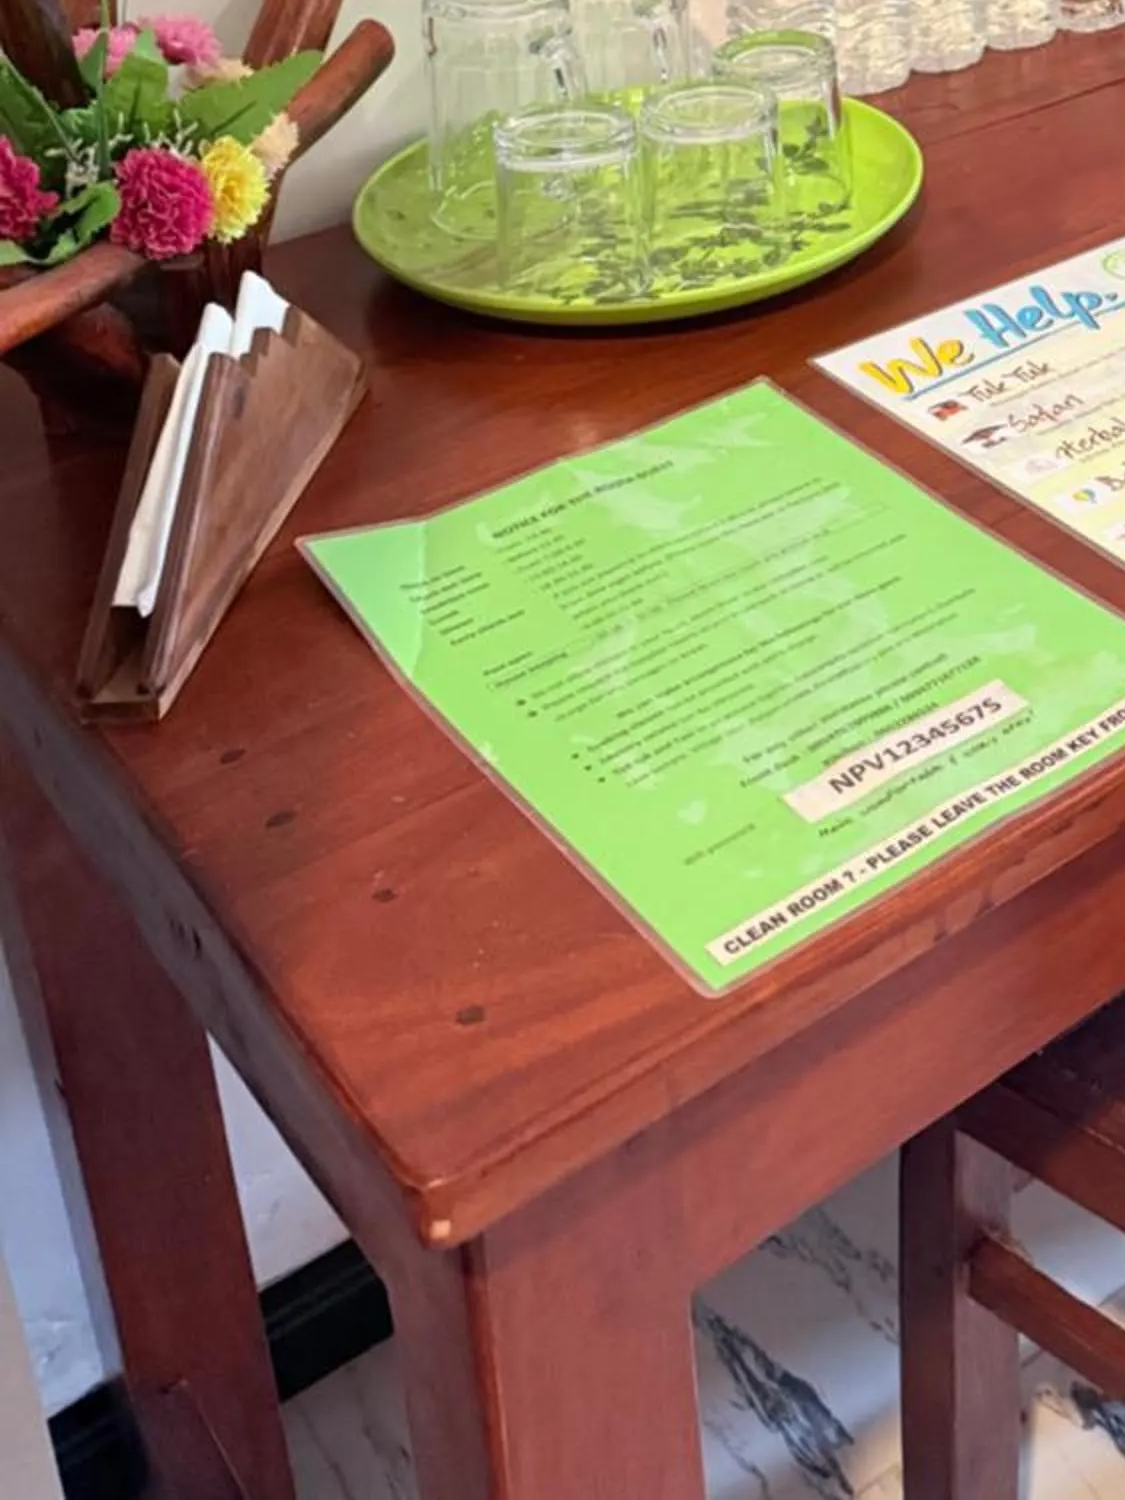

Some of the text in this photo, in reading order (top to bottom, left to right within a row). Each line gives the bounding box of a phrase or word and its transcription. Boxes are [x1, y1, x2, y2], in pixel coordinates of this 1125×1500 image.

[861, 338, 975, 393] We
[966, 359, 1054, 403] Tuk Tuk
[724, 913, 787, 953] CLEAN
[787, 879, 843, 916] ROOM
[841, 870, 856, 883] ?
[866, 825, 933, 869] PLEASE
[931, 793, 986, 828] LEAVE
[984, 774, 1022, 796] THE
[1018, 747, 1069, 780] ROOM
[1066, 727, 1099, 752] KEY
